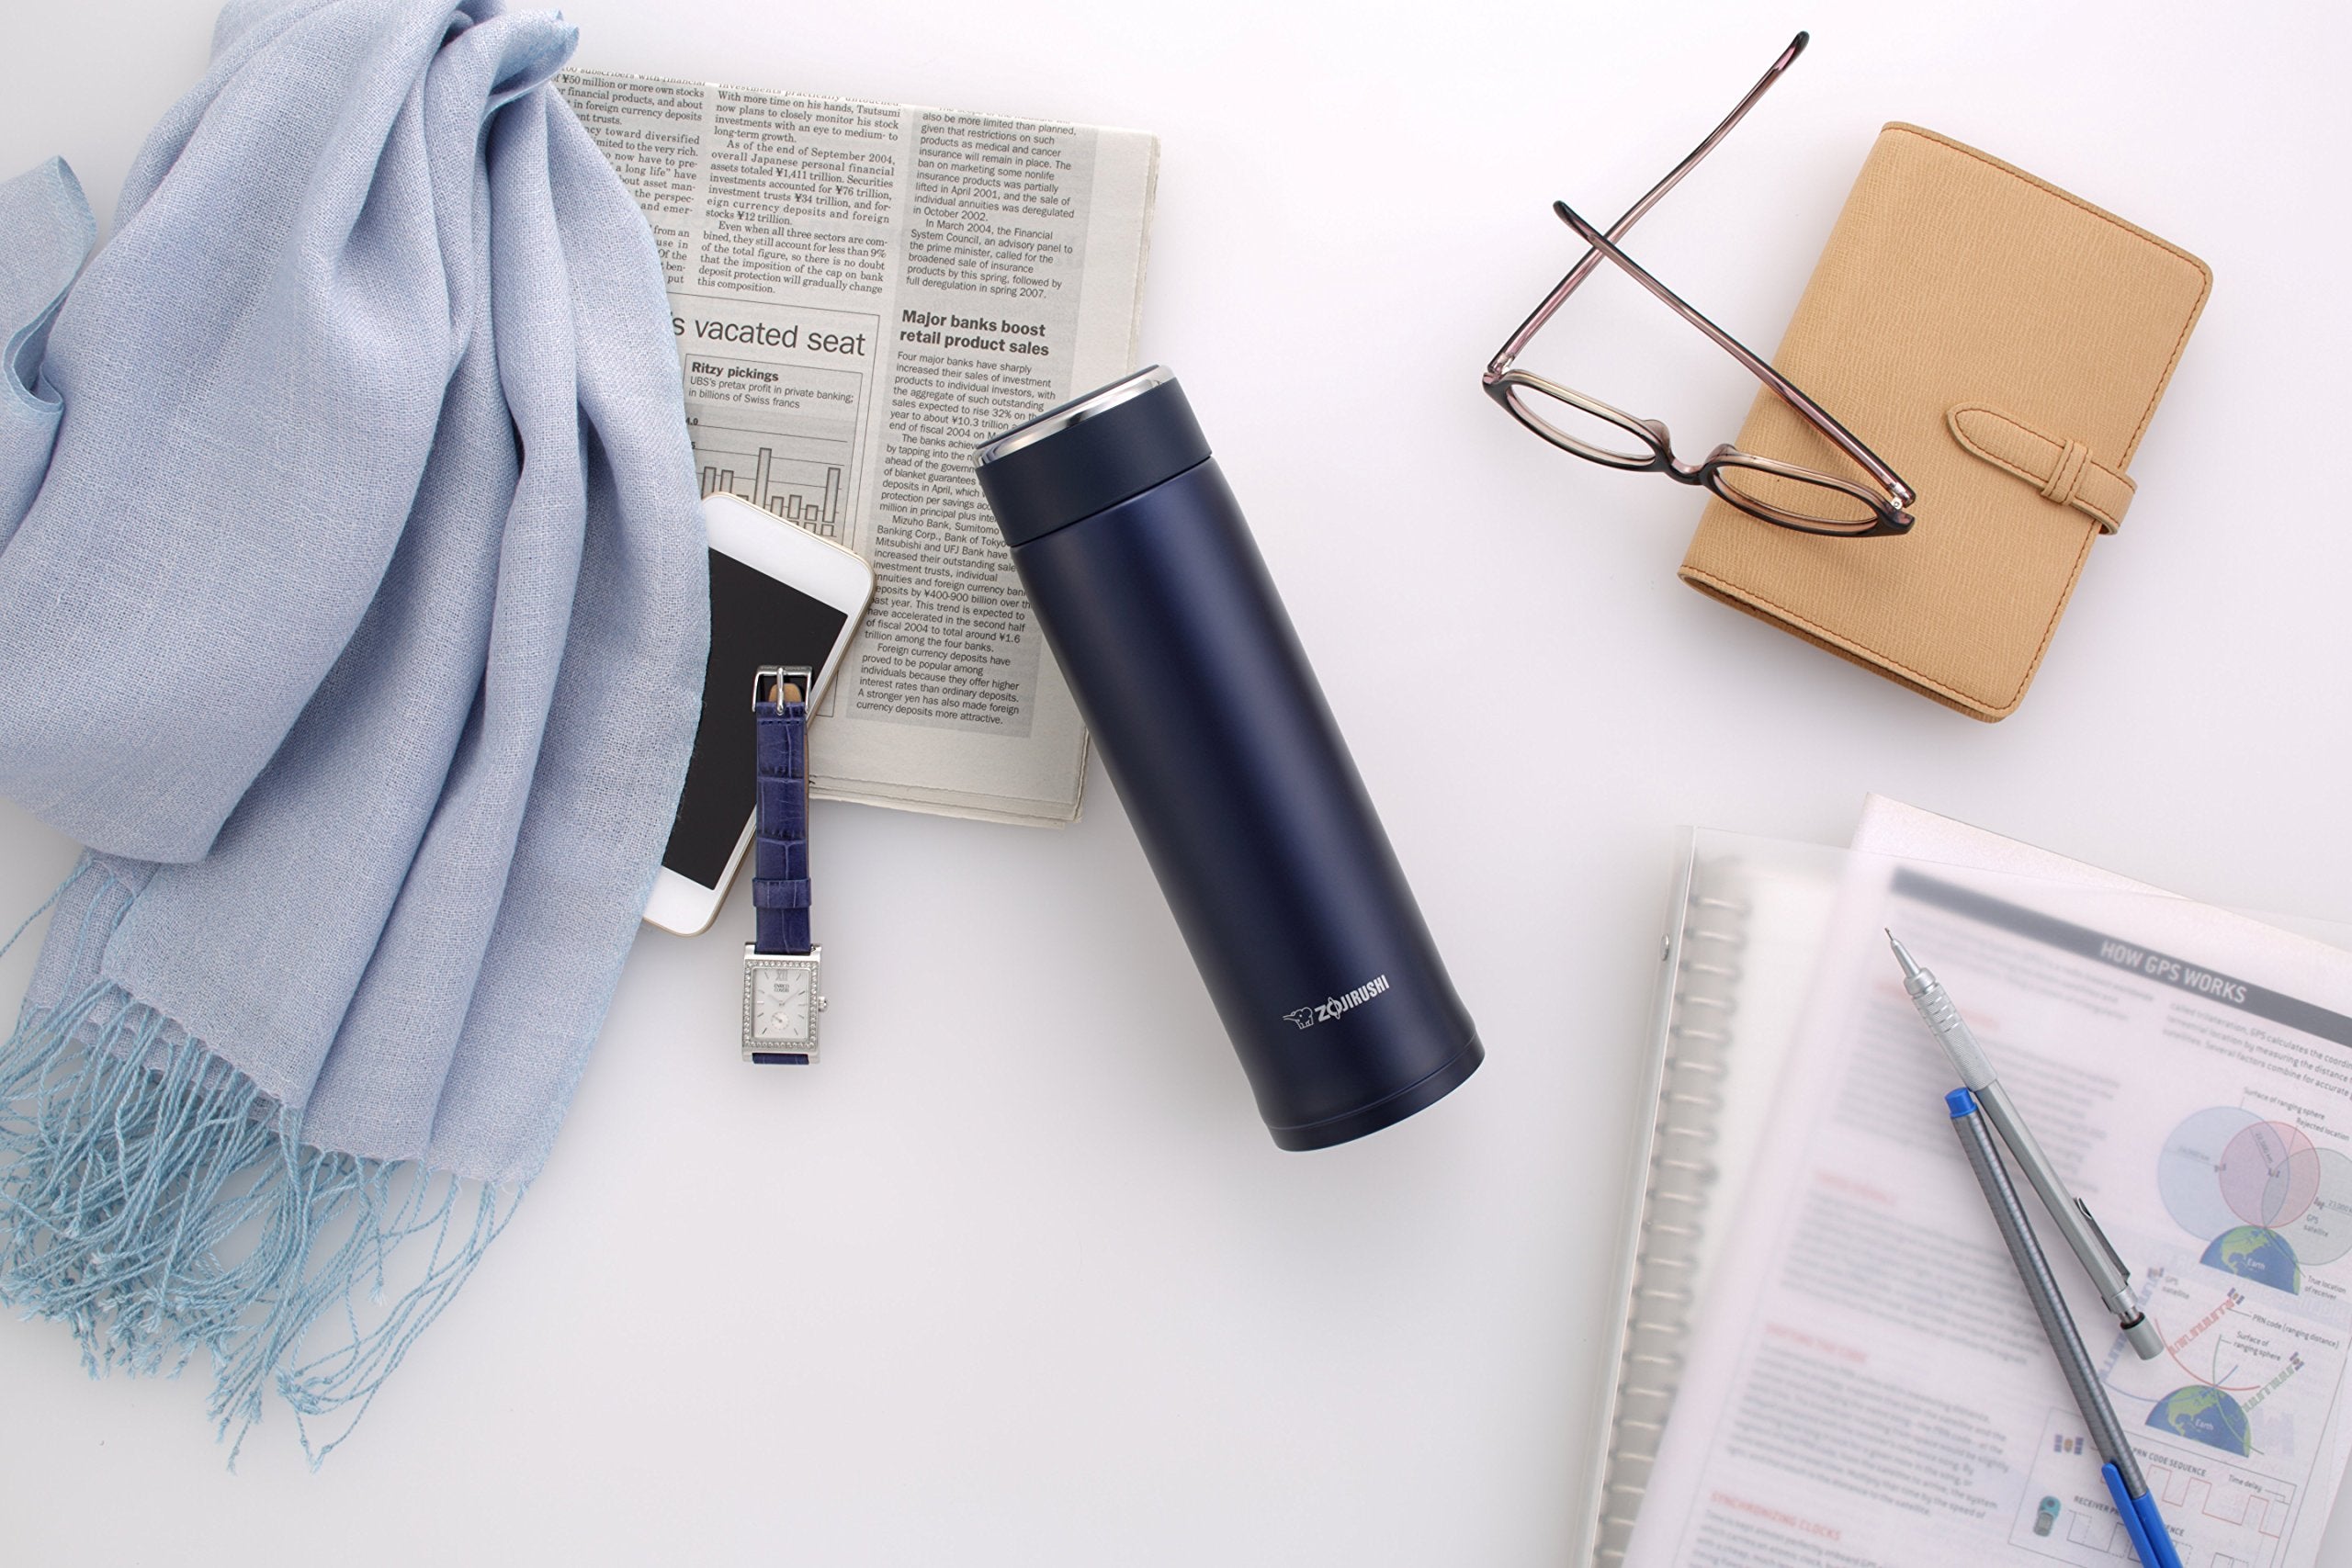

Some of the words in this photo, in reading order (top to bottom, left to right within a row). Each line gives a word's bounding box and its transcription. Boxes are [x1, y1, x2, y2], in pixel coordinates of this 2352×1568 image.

[562, 74, 581, 85] ¥50
[582, 77, 616, 88] million
[629, 84, 654, 93] more
[655, 86, 673, 95] own
[675, 88, 705, 97] stocks
[718, 90, 741, 102] With
[743, 96, 768, 105] more
[770, 96, 791, 107] time
[807, 99, 821, 109] his
[823, 101, 854, 115] hands,
[856, 105, 900, 118] Tsutsumi
[716, 105, 736, 113] now
[739, 105, 764, 116] plans
[768, 108, 777, 118] to
[780, 109, 813, 122] closely
[815, 114, 854, 125] monitor
[857, 116, 871, 127] his
[874, 119, 899, 130] stock
[922, 112, 942, 122] also
[944, 114, 956, 123] be
[957, 117, 981, 126] more
[983, 118, 1013, 130] limited
[1016, 121, 1036, 130] than
[1038, 124, 1076, 136] planned,
[609, 130, 641, 139] toward
[645, 130, 700, 145] diversified
[626, 141, 636, 150] to
[637, 141, 652, 152] the
[654, 146, 675, 156] very
[677, 146, 698, 157] rich.
[726, 139, 740, 149] As
[743, 141, 754, 151] of
[757, 142, 774, 152] the
[776, 145, 795, 154] end
[797, 146, 809, 156] of
[811, 147, 865, 162] September
[868, 152, 895, 165] 2004,
[710, 164, 739, 173] assets
[741, 164, 774, 176] totaled
[775, 167, 807, 179] ¥1,411
[809, 172, 844, 183] trillion.
[846, 174, 893, 188] Securities
[915, 182, 938, 193] lifted
[941, 185, 948, 194] in
[951, 186, 971, 197] April
[973, 187, 1001, 200] 2001,
[1003, 193, 1021, 201] and
[1023, 193, 1037, 203] the
[1040, 196, 1058, 205] sale
[1061, 197, 1071, 206] of
[913, 206, 922, 214] in
[923, 206, 959, 219] October
[961, 210, 988, 221] 2002.
[697, 276, 716, 287] this
[717, 281, 775, 293] composition.
[698, 265, 732, 277] deposit
[733, 271, 781, 283] protection
[783, 275, 801, 285] will
[802, 277, 848, 291] gradually
[849, 281, 883, 295] change
[906, 276, 920, 286] full
[922, 277, 977, 291] deregulation
[979, 283, 988, 292] in
[989, 286, 1018, 298] spring
[1019, 287, 1046, 299] 2007.
[901, 310, 947, 328] Major
[950, 314, 998, 332] banks
[1001, 320, 1046, 337] boost
[695, 320, 798, 348] vacated
[807, 332, 866, 356] seat
[899, 330, 941, 344] retail
[944, 335, 1006, 352] product
[1009, 341, 1049, 356] sales
[691, 361, 724, 378] Ritzy
[727, 366, 779, 383] pickings
[898, 351, 918, 361] Four
[919, 355, 944, 366] major
[946, 356, 974, 367] banks
[976, 359, 998, 370] have
[1000, 363, 1033, 376] sharply
[688, 388, 696, 397] in
[699, 389, 730, 401] billions
[732, 393, 743, 402] of
[744, 393, 770, 405] Swiss
[773, 397, 800, 409] francs
[690, 376, 717, 387] UBS's
[718, 380, 746, 390] pretax
[748, 384, 772, 393] profit
[774, 385, 782, 394] in
[785, 387, 814, 398] private
[817, 390, 854, 404] banking;
[892, 514, 924, 526] Mizuho
[926, 518, 952, 531] Bank,
[955, 522, 999, 536] Sumitomo
[865, 630, 892, 641] trillion
[894, 635, 925, 647] among
[927, 637, 942, 647] the
[944, 638, 963, 649] four
[964, 641, 994, 652] banks.
[856, 701, 894, 714] currency
[895, 705, 933, 716] deposits
[935, 710, 958, 719] more
[960, 713, 1003, 724] attractive.
[2100, 941, 2143, 967] HOW
[2144, 954, 2181, 982] GPS
[2183, 967, 2248, 1004] WORKS
[1315, 975, 1390, 1022] ZOJIRUSHI
[2310, 1049, 2323, 1060] the
[2300, 1060, 2313, 1071] the
[2314, 1066, 2348, 1082] distance
[2302, 1074, 2314, 1084] for
[2315, 1080, 2349, 1097] accurate
[2302, 1108, 2325, 1121] sphere
[2246, 1258, 2266, 1270] Earth
[2252, 1314, 2267, 1325] PRN
[2267, 1320, 2282, 1330] code
[2148, 1452, 2169, 1465] CODE
[2169, 1459, 2207, 1477] SEQUENCE
[2228, 1473, 2244, 1485] Time
[2244, 1481, 2263, 1494] delay
